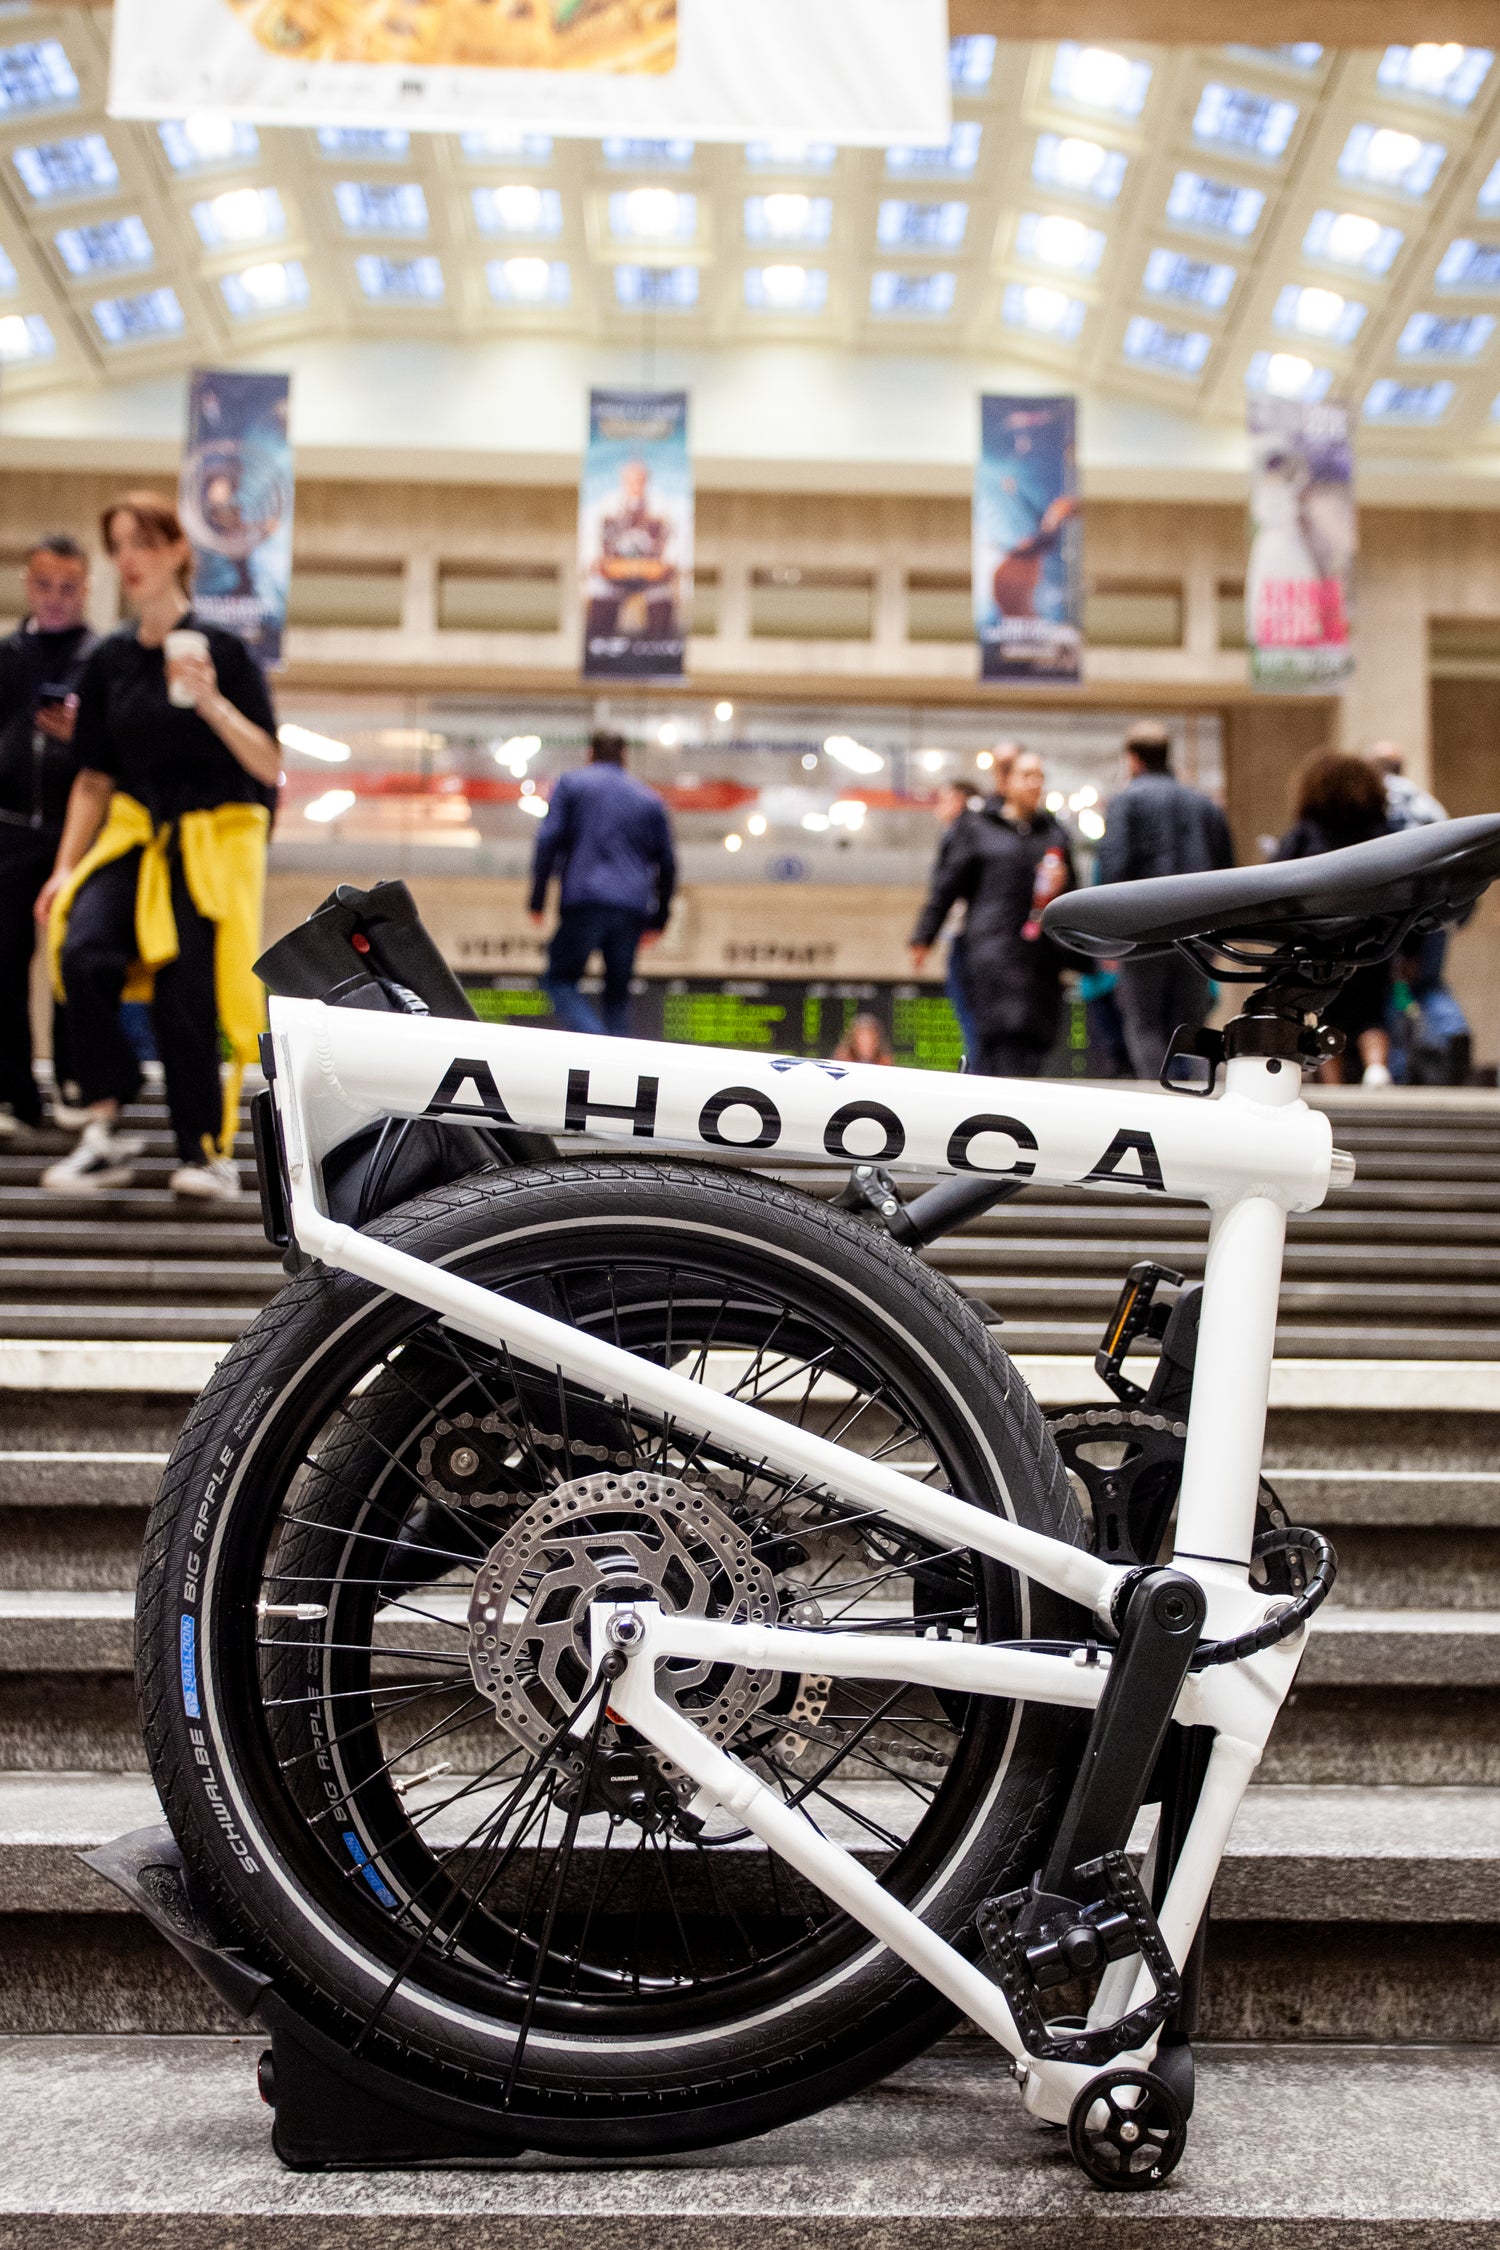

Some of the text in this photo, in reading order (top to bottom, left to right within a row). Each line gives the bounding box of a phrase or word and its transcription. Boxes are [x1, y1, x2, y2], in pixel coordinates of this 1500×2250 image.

[419, 1057, 1167, 1192] AHOOCA
[183, 1444, 235, 1603] BIG APPLE
[182, 1621, 194, 1688] BALLOON
[308, 1686, 331, 1771] APPLE
[190, 1728, 261, 1874] SCHWALBE
